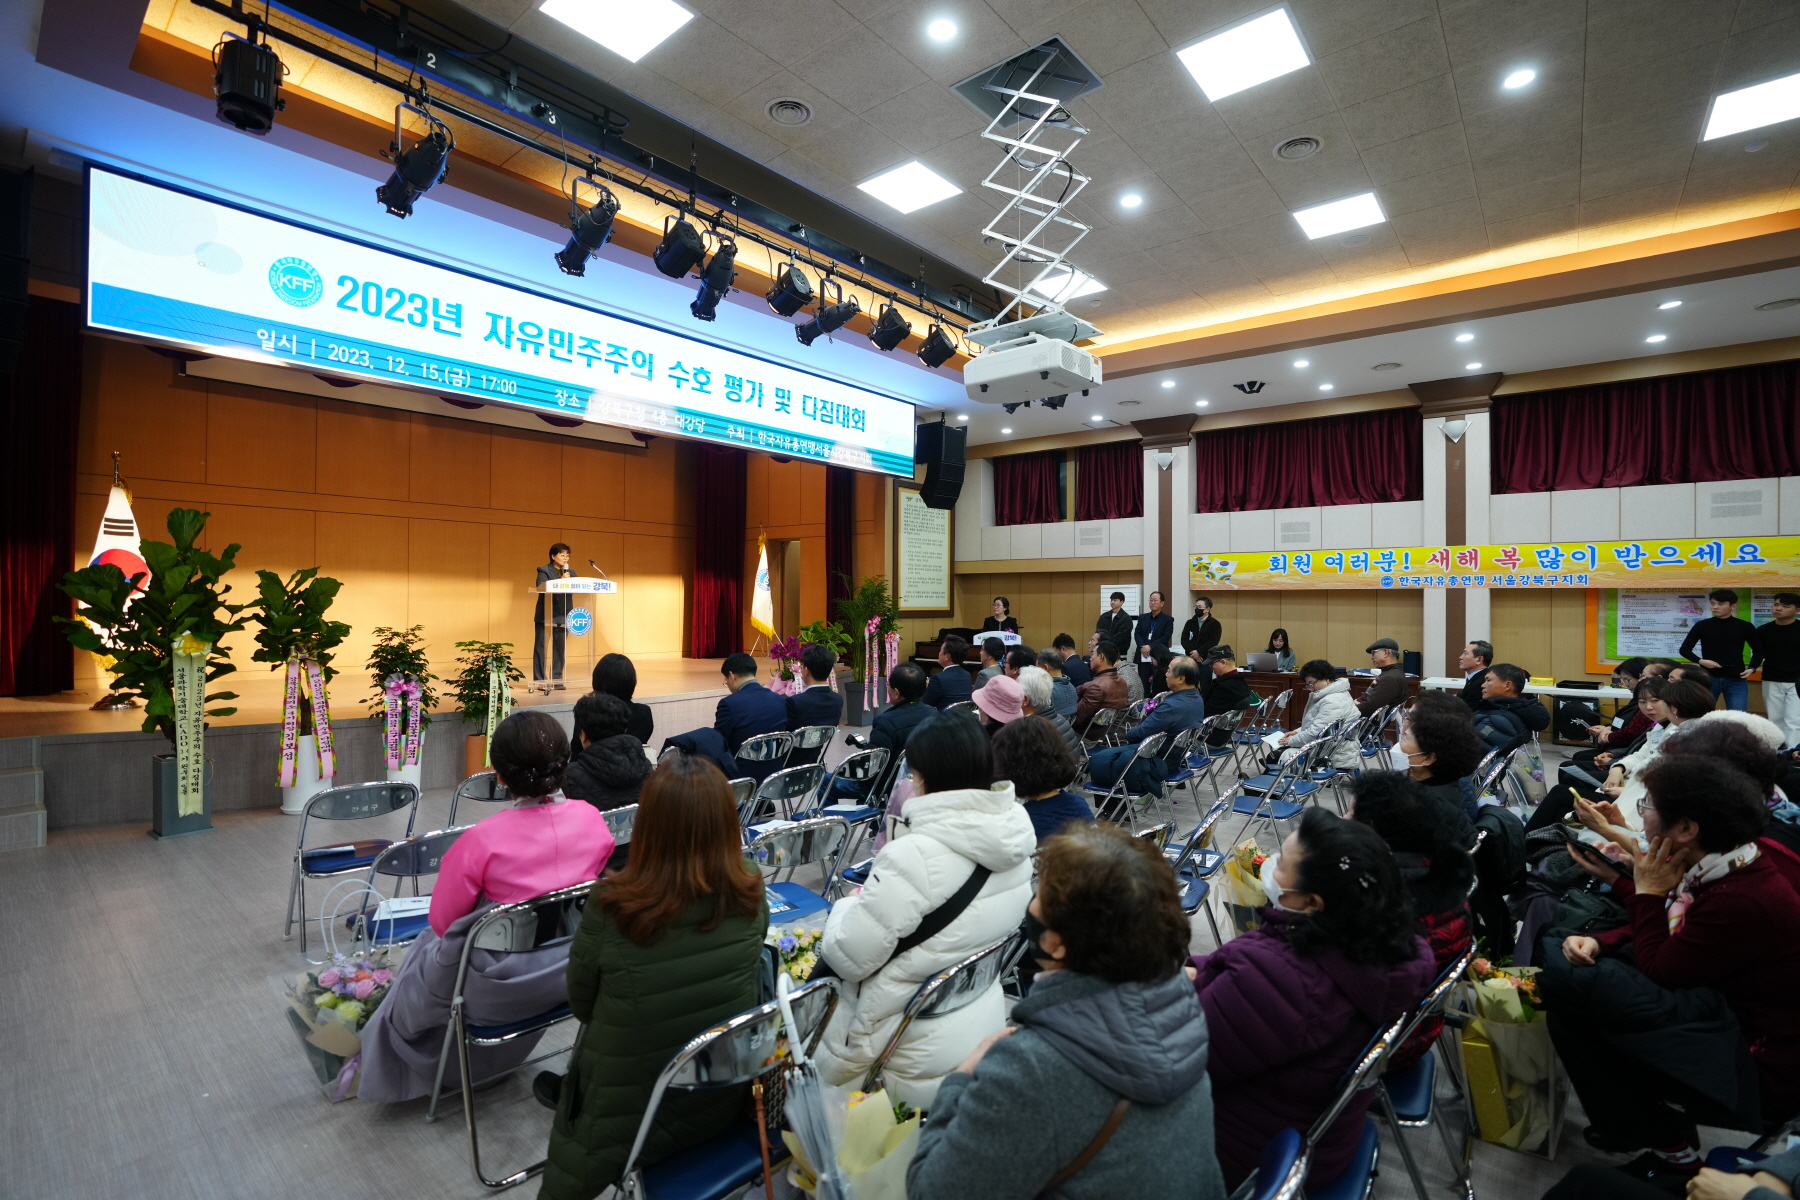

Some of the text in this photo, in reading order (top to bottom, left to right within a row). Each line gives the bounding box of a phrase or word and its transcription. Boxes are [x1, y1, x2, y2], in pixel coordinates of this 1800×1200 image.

[427, 53, 436, 69] 2
[279, 272, 314, 292] KFF
[256, 328, 297, 355] 일시
[328, 343, 374, 370] 2023.
[386, 357, 410, 376] 12.
[420, 362, 471, 388] 15.(금)
[480, 373, 517, 396] 17:00
[336, 275, 867, 433] 2023년 자유민주주의 수호 평가 및 다짐대회
[555, 388, 581, 407] 장소
[600, 399, 646, 422] 강북구청
[652, 409, 669, 427] 4층
[674, 414, 706, 434] 대강당
[726, 424, 745, 441] 주최
[1268, 541, 1767, 575] 회원 여러분! 새해 복 많이 받으세요
[592, 582, 611, 591] 강북!
[1398, 575, 1485, 588] 한국자유총연맹
[1491, 574, 1589, 587] 서울강북구지회
[571, 618, 588, 627] KFF
[192, 752, 202, 766] 수호
